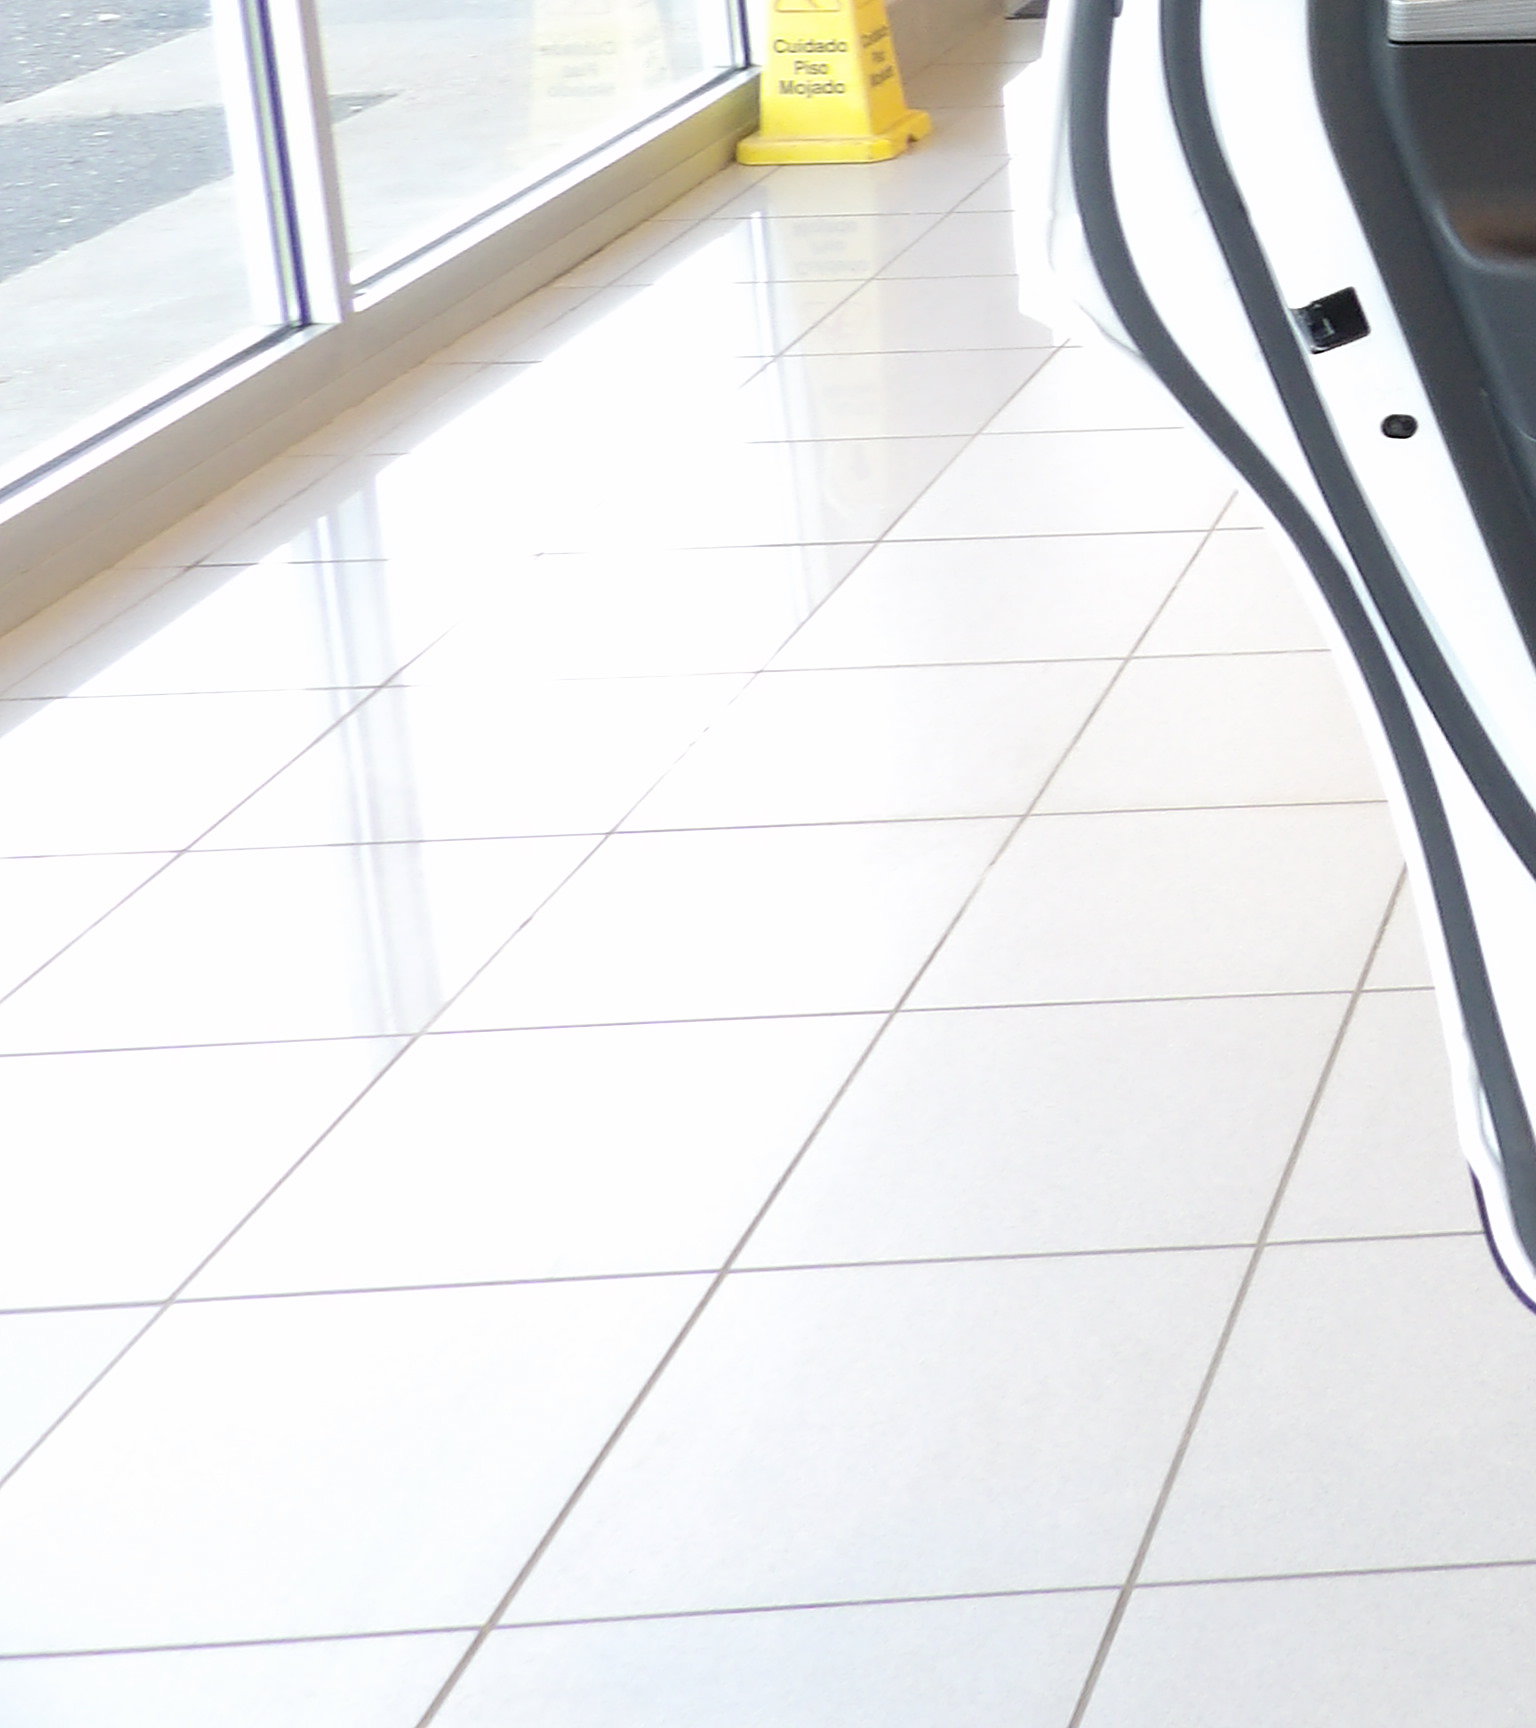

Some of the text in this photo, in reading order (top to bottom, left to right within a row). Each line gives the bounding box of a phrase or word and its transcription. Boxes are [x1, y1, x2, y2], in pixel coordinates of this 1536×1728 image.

[774, 38, 848, 53] Cuidado
[793, 59, 828, 75] Piso
[778, 79, 845, 98] Mojado
